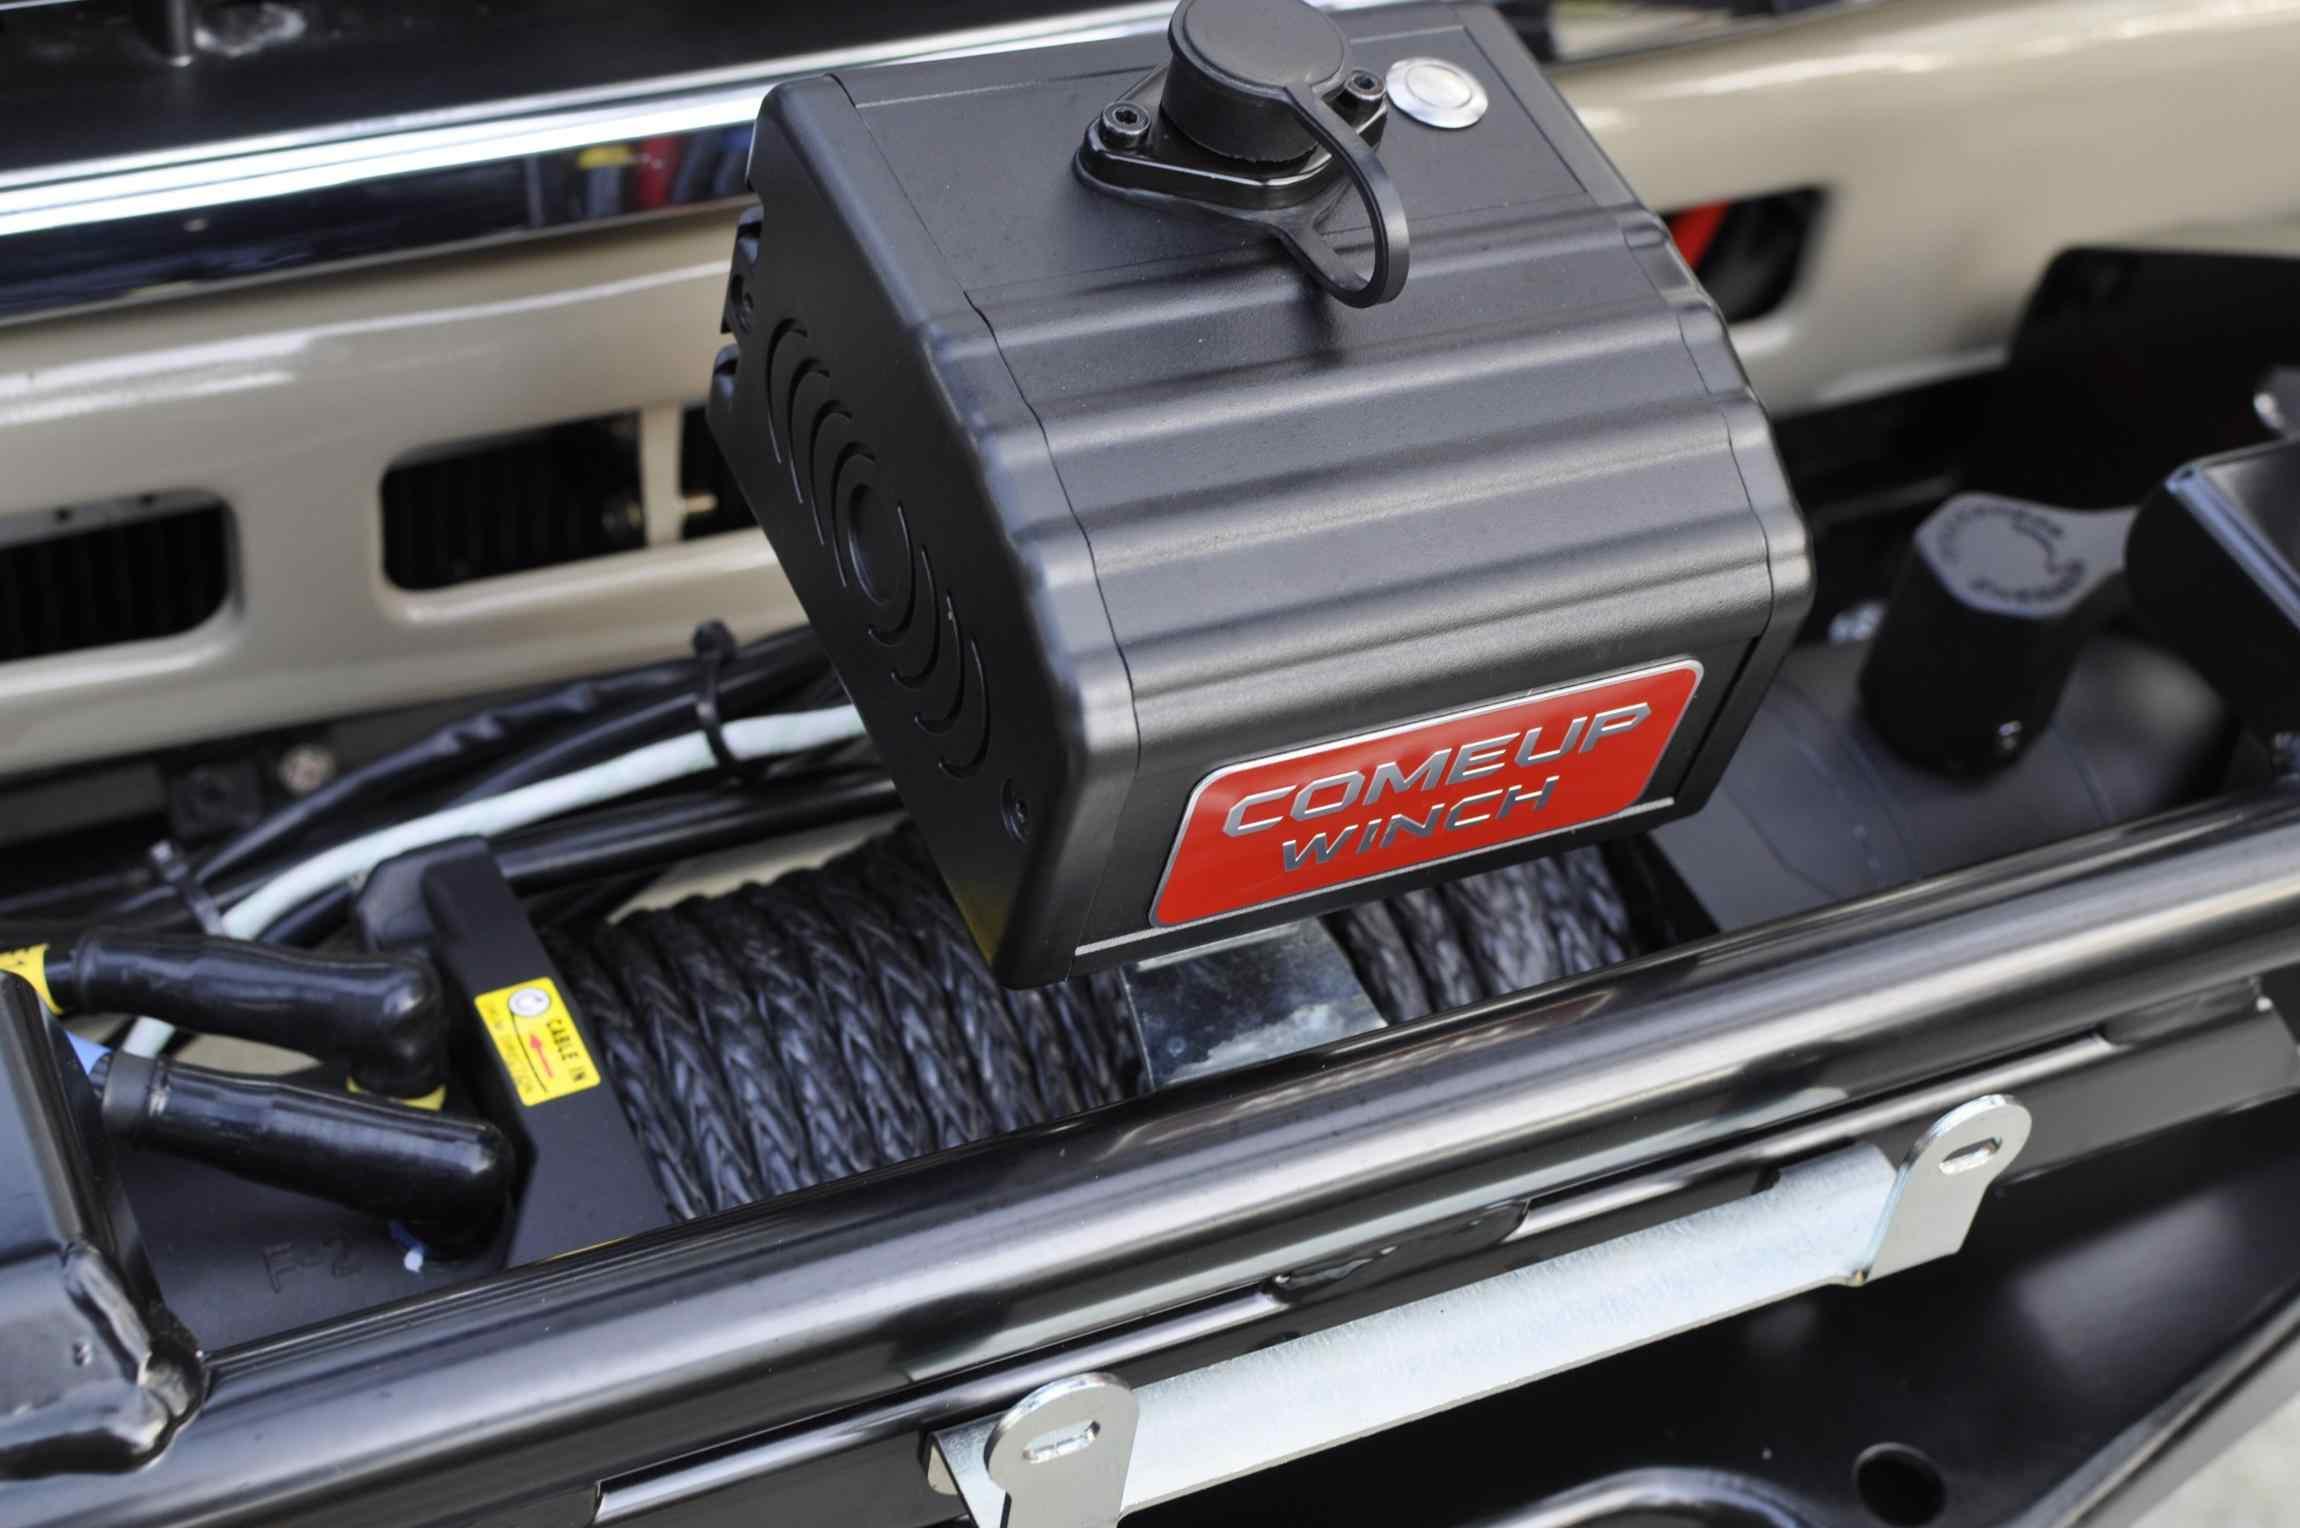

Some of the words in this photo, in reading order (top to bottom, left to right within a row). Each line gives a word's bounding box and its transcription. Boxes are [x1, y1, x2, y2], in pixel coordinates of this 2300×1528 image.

[1223, 702, 1651, 837] COMEUP
[1282, 776, 1559, 873] WINCH
[546, 1019, 579, 1061] CABLE
